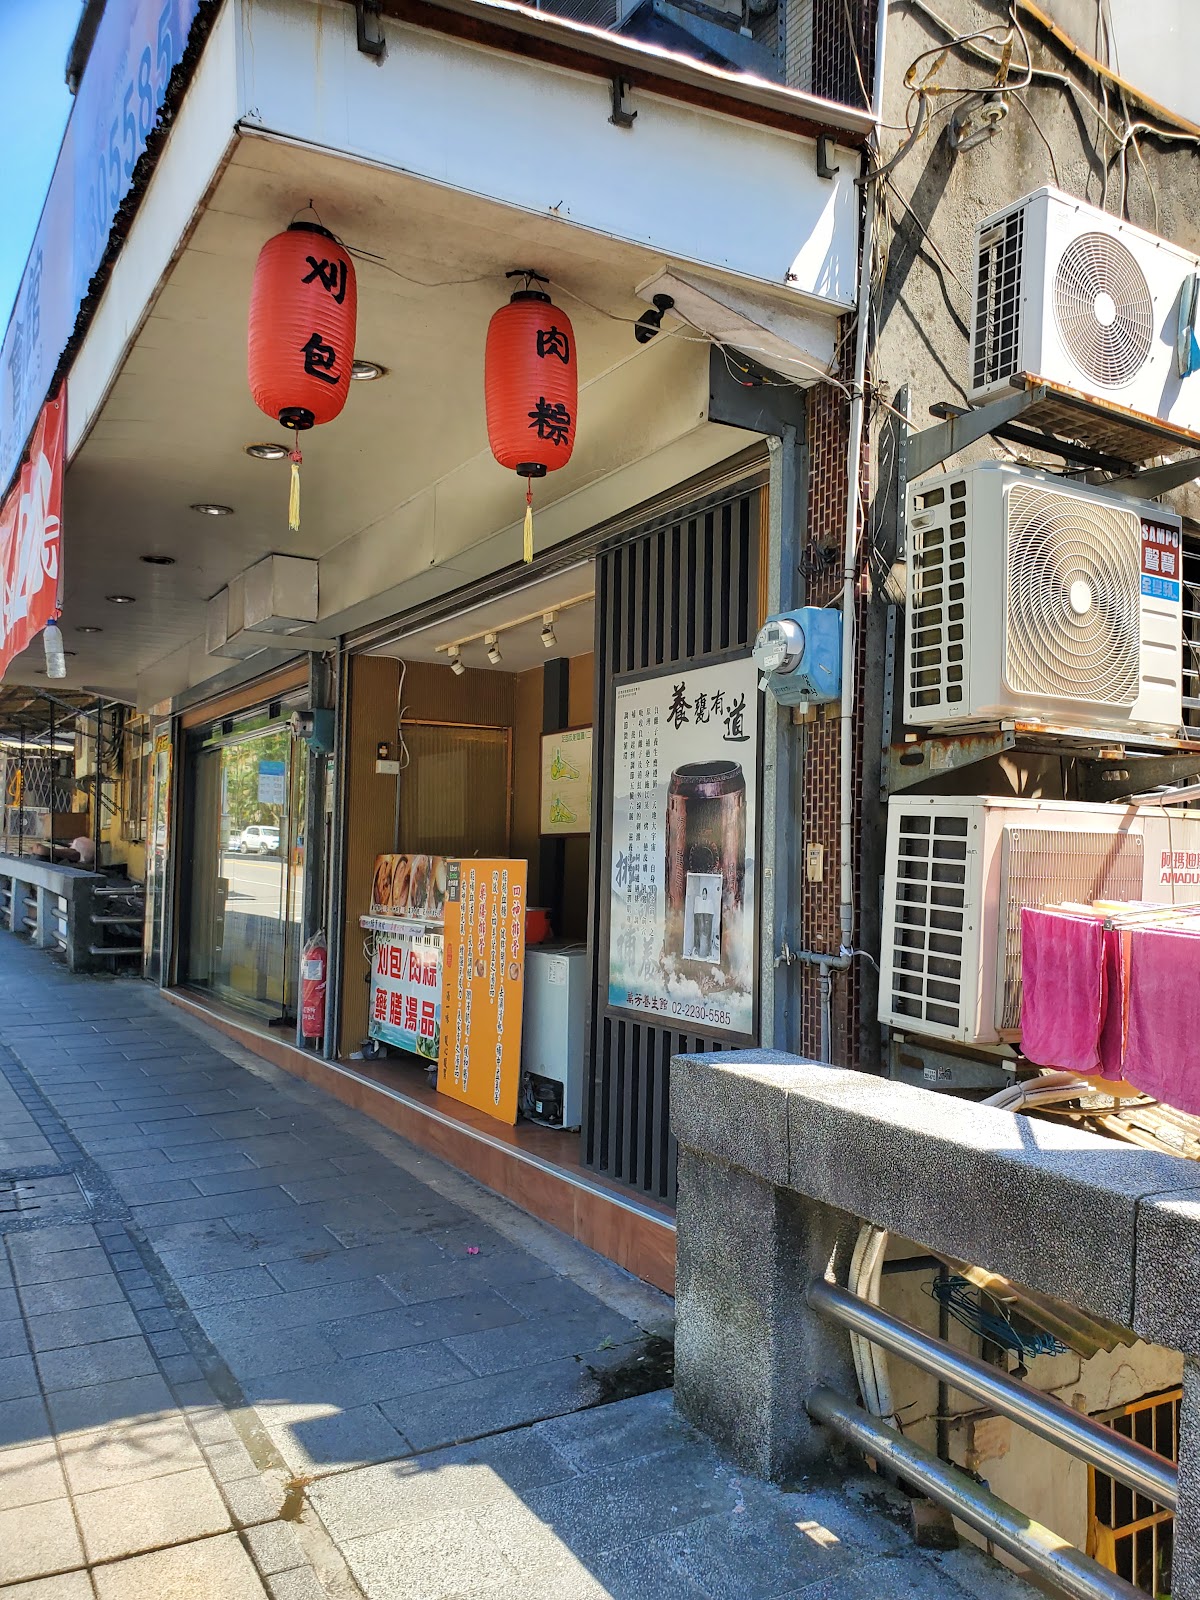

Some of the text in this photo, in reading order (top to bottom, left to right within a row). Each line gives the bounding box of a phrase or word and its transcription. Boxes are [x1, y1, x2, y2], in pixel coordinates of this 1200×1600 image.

[299, 255, 348, 385] 刈包
[527, 325, 571, 446] 肉粽
[1141, 523, 1179, 549] SAMPO
[1144, 546, 1176, 576] 聲寶
[1161, 872, 1200, 884] AMADU
[374, 987, 436, 1038] 藥膳湯品
[672, 1001, 731, 1025] 02-2230-5585
